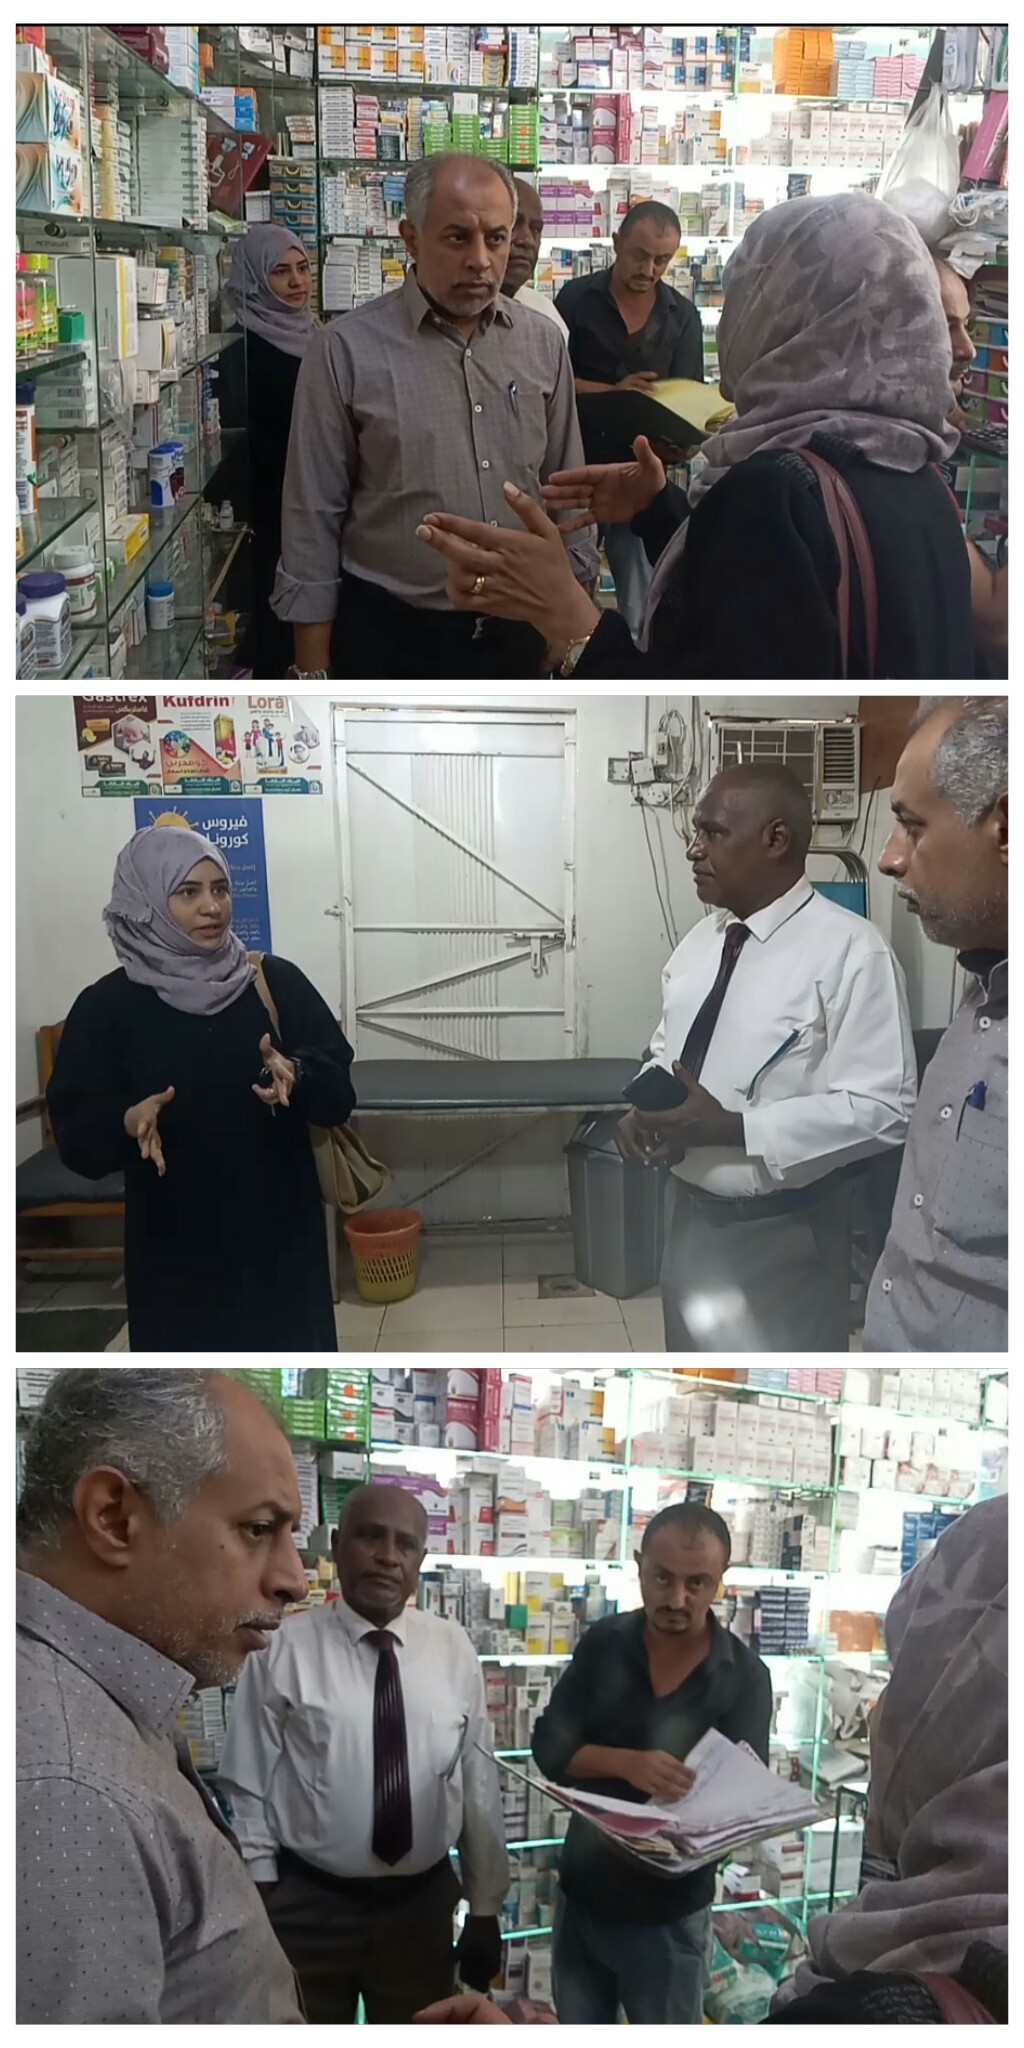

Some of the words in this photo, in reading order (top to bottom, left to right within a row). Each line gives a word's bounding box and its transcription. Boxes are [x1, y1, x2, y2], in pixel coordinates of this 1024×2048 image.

[163, 695, 230, 707] Kufdrin
[202, 815, 248, 830] فيروس
[206, 833, 249, 849] كورونا
